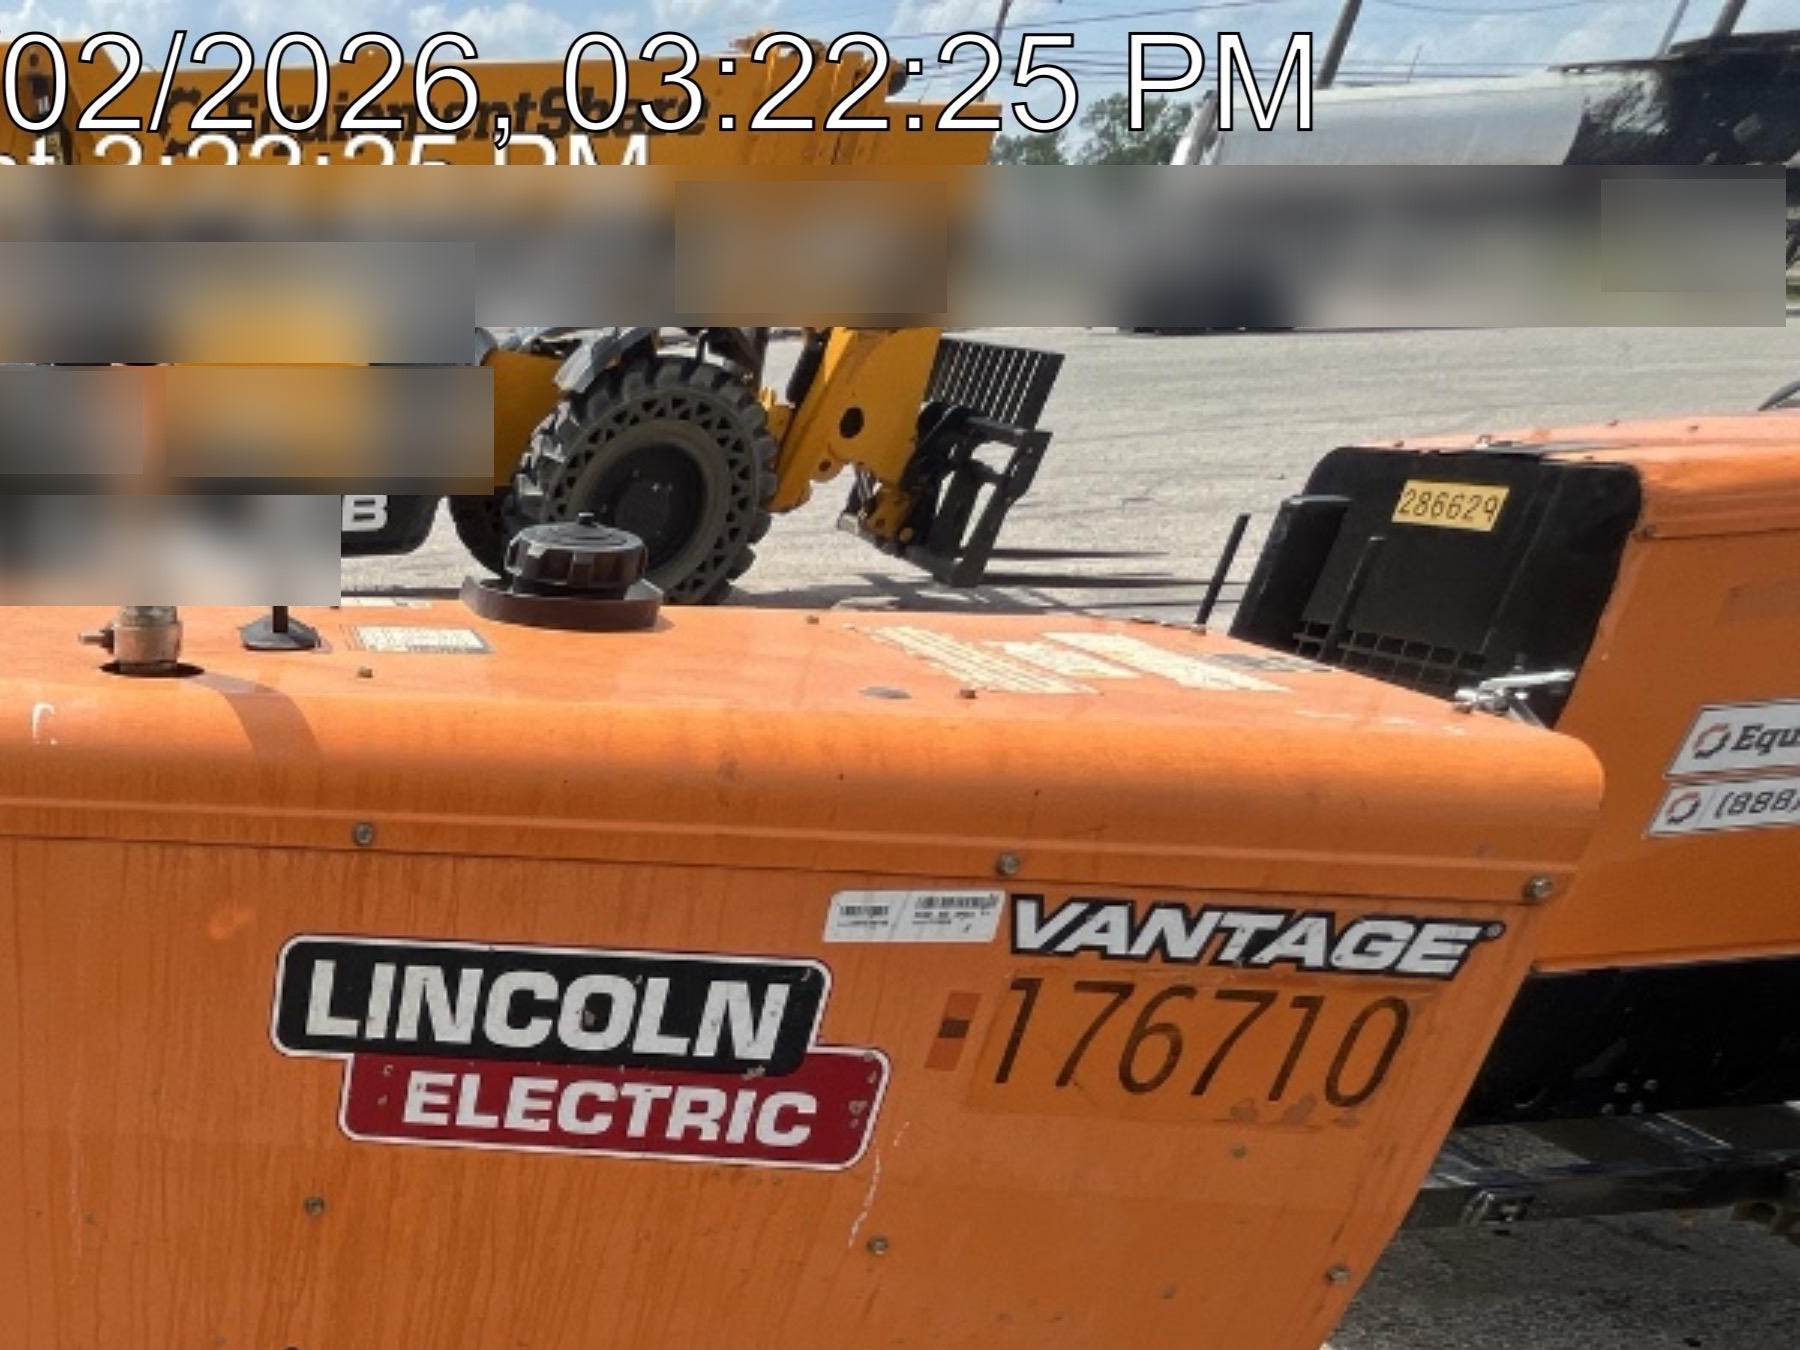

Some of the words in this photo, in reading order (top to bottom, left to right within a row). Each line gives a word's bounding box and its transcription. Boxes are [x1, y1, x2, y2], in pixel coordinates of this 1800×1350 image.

[1398, 487, 1498, 523] 286629
[1012, 896, 1488, 978] VANTAGE
[305, 958, 790, 1060] LINCOLN
[994, 977, 1410, 1108] 176710
[402, 1069, 817, 1148] ELECTRIC
